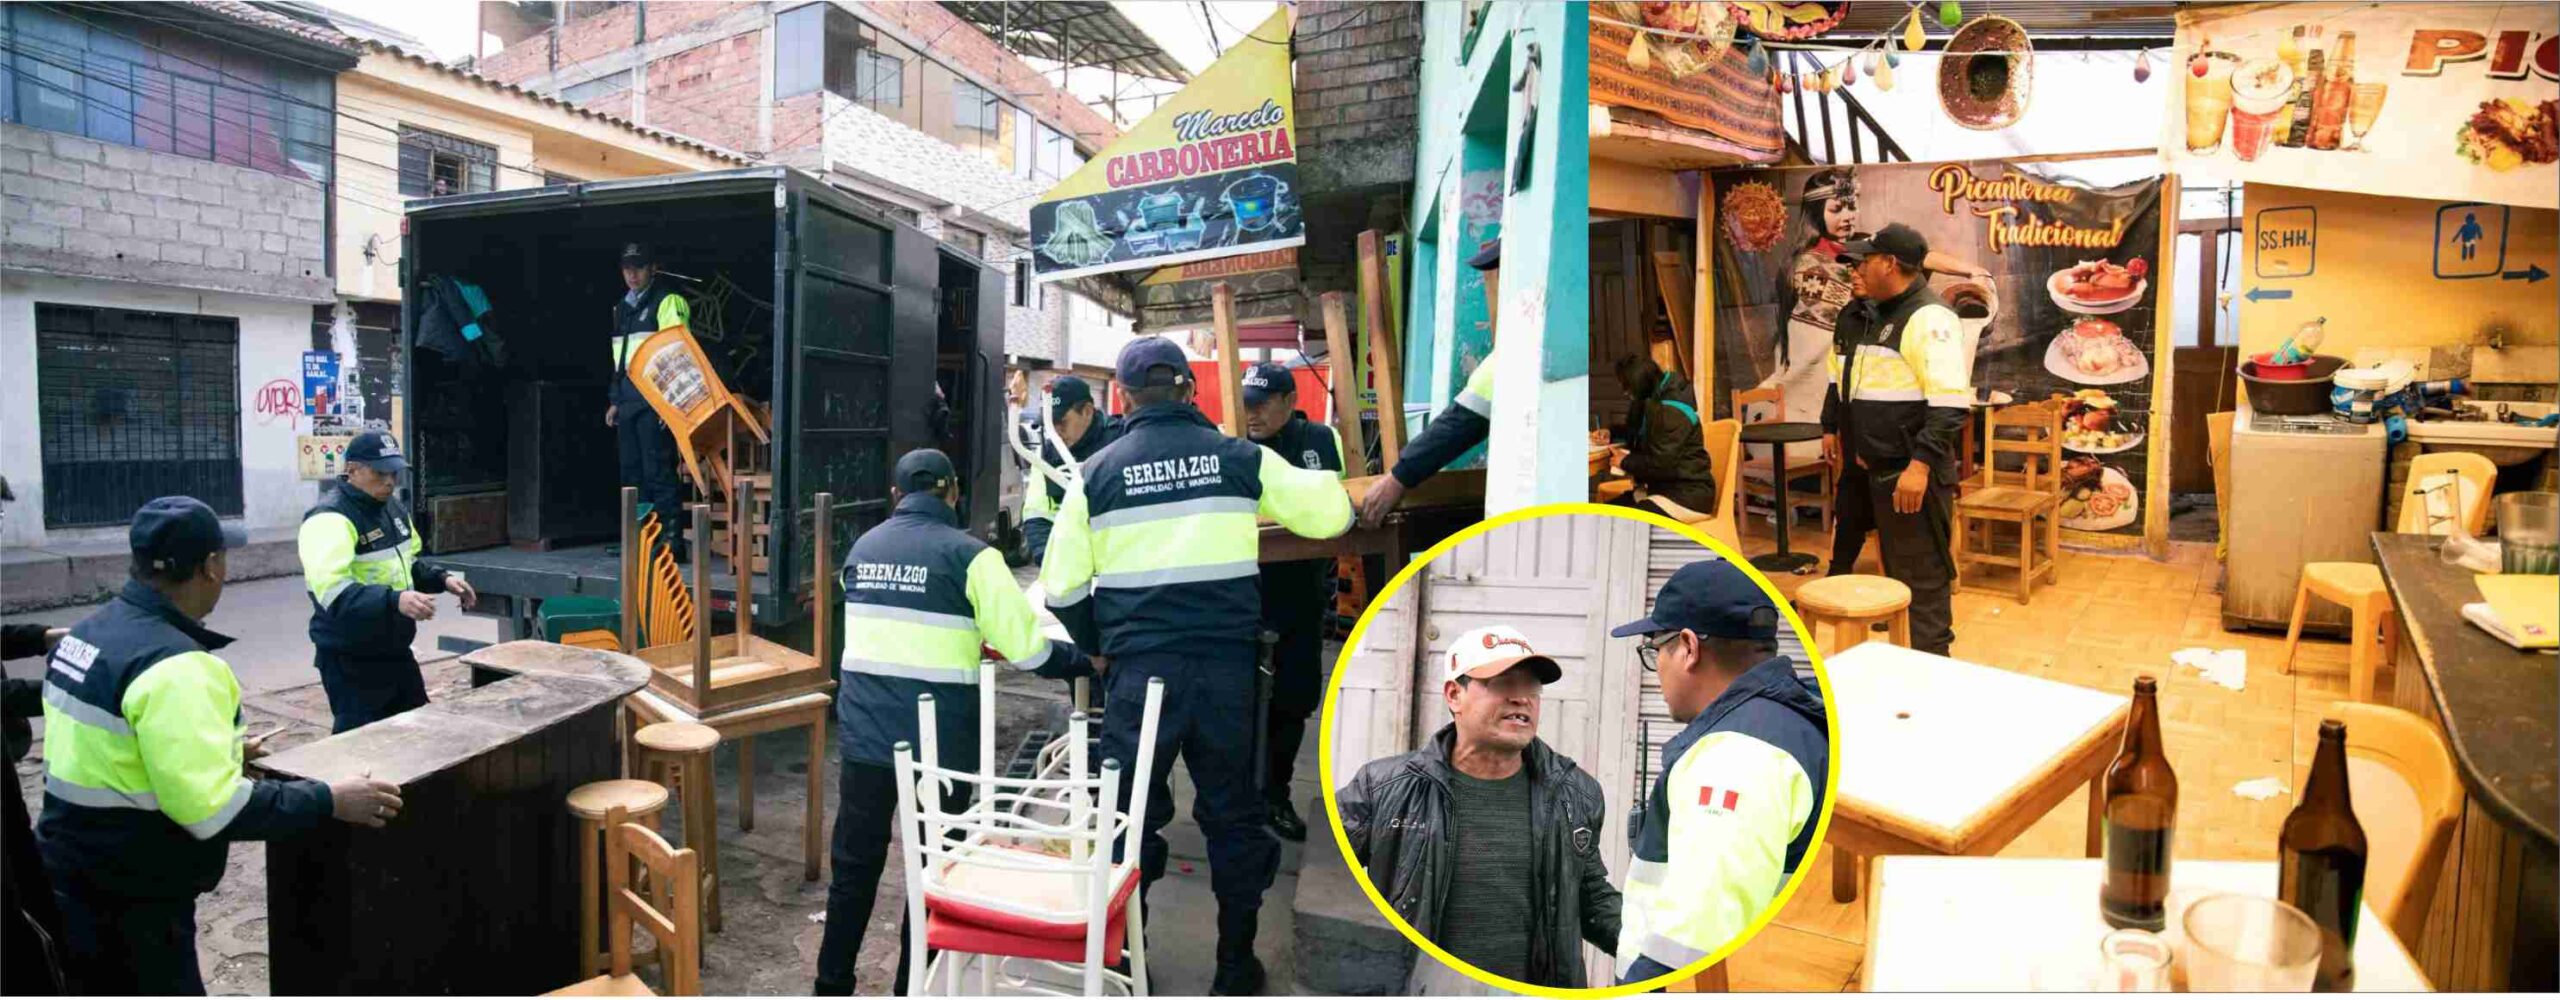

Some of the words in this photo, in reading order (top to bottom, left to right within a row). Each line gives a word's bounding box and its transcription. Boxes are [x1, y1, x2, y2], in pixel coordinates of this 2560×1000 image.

[1173, 98, 1285, 142] Marcelo
[1106, 127, 1294, 188] CARBONERIA
[1928, 163, 2074, 214] Picanteria
[1971, 206, 2124, 253] Tradicional
[2260, 229, 2311, 250] SS.HH.
[1123, 455, 1220, 486] SERENAZGO
[1176, 480, 1186, 489] DE
[856, 563, 928, 584] SERENAZGO
